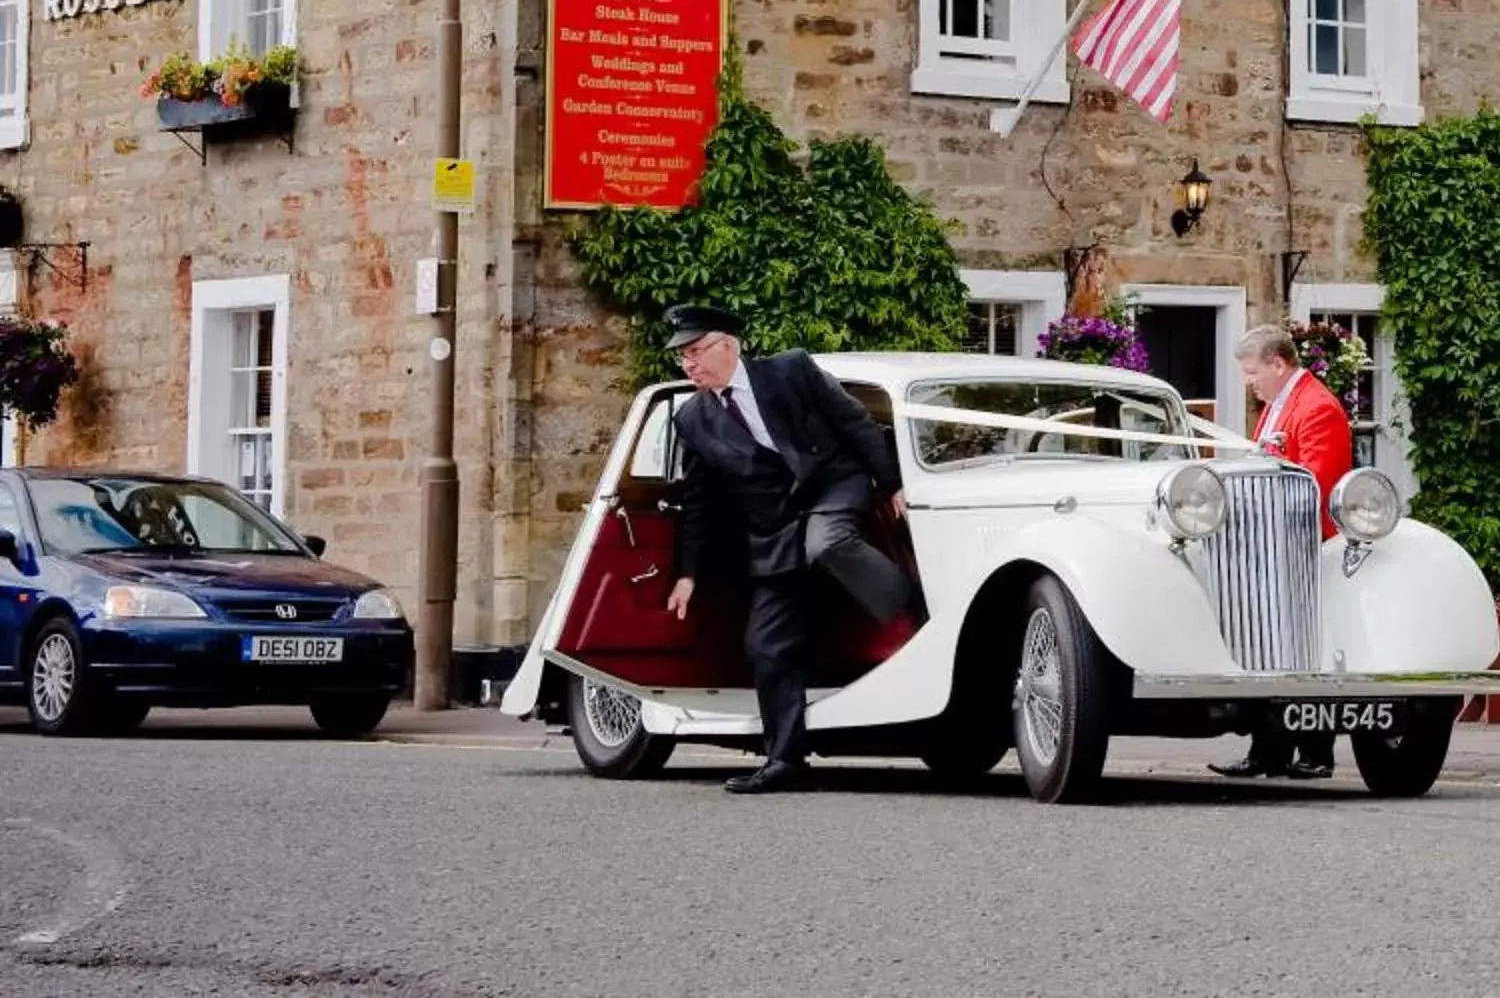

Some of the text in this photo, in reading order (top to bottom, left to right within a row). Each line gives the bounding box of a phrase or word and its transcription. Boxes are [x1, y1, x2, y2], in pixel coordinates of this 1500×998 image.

[595, 4, 680, 24] Steak House
[560, 27, 713, 53] Bar Meals and Suppers
[590, 54, 684, 75] Weddings and
[577, 73, 696, 95] Conference Venue
[563, 98, 704, 124] Garden Conservatory
[598, 129, 676, 147] Ceremonies
[579, 151, 588, 165] 4
[592, 151, 637, 168] Poster
[639, 156, 656, 168] en
[604, 166, 669, 183] Bedrooms
[1283, 703, 1394, 731] CBN 545
